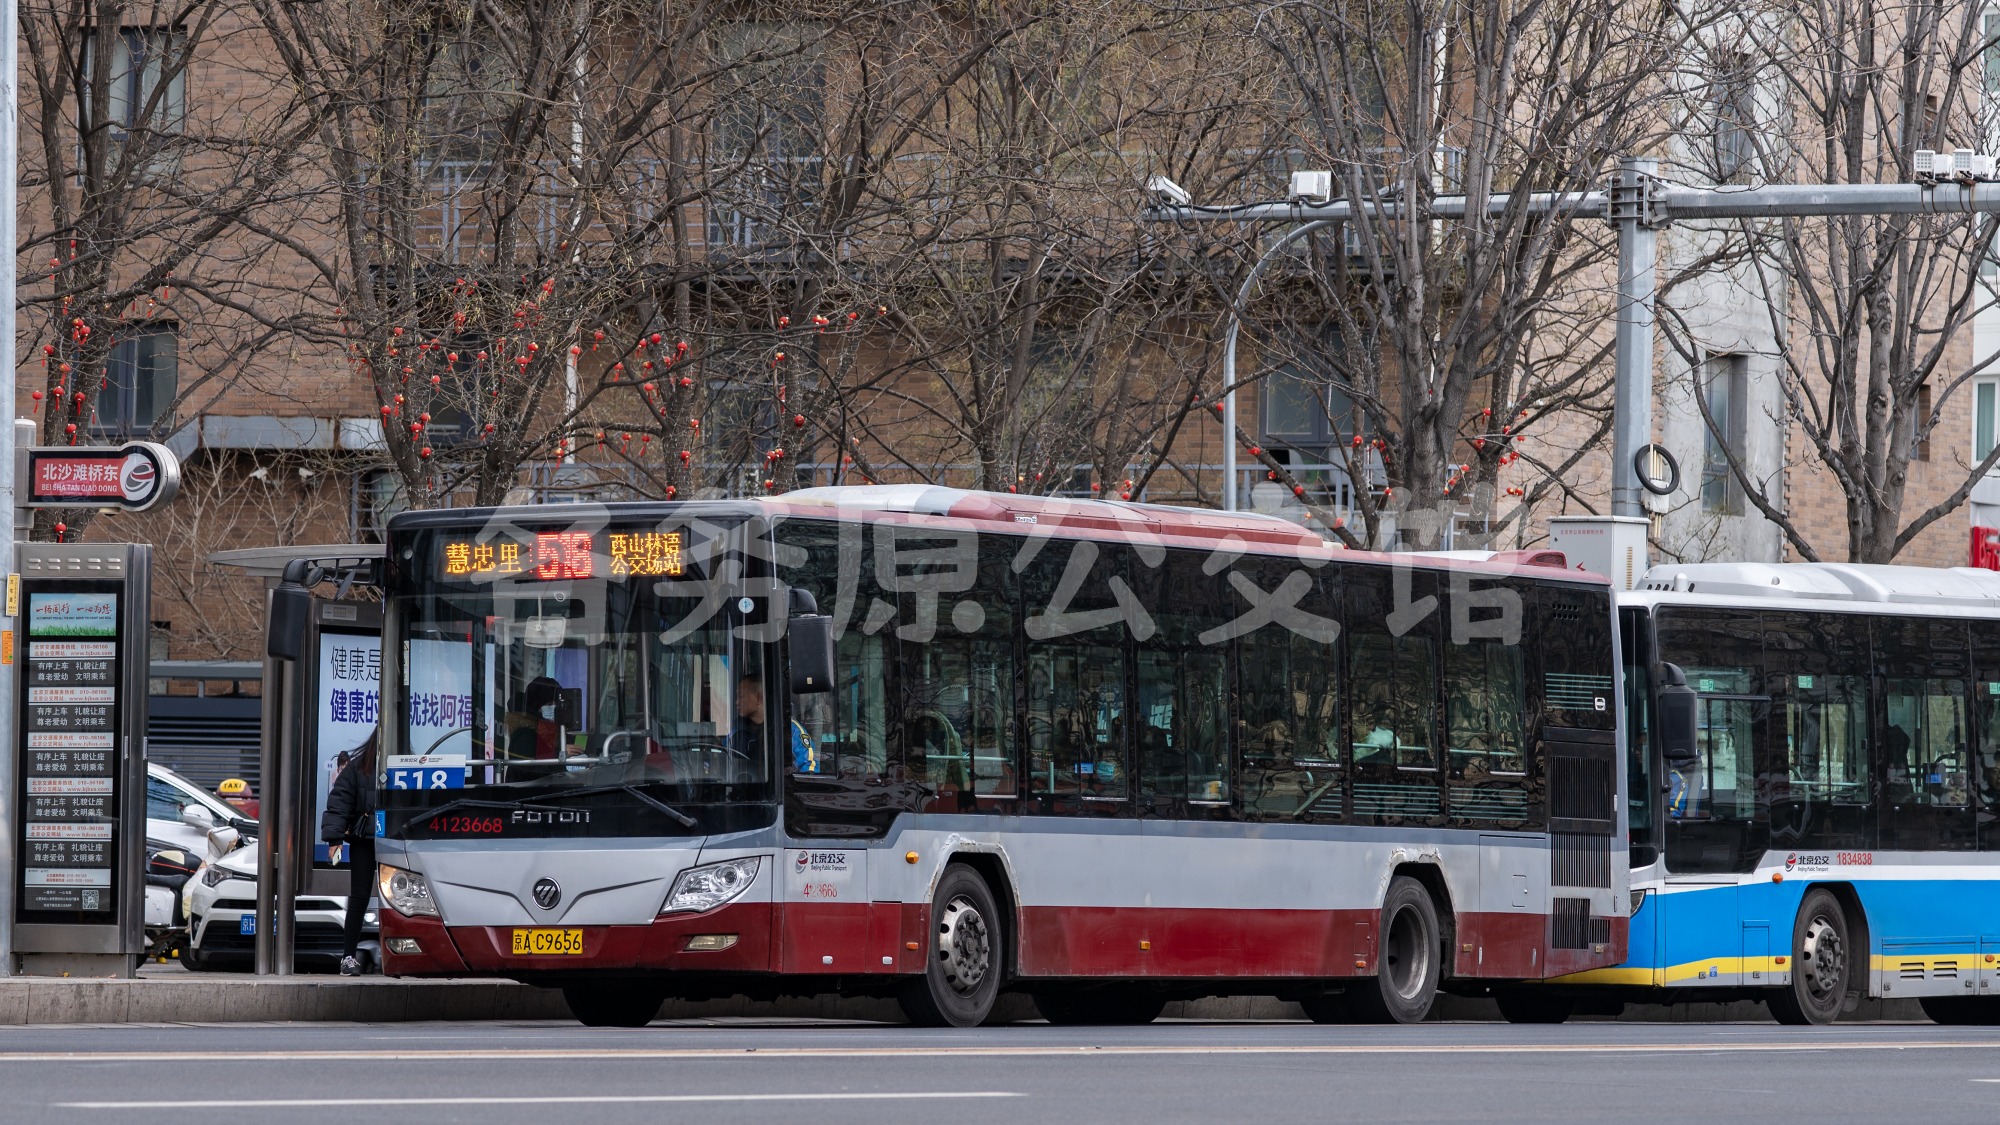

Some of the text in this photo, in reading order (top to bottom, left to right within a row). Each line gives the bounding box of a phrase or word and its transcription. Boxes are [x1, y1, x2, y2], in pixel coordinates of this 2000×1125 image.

[42, 463, 119, 482] 北沙滩桥东
[41, 483, 118, 493] BEI SHA TAN QIAO DONG
[610, 533, 681, 555] 西山林语
[446, 533, 592, 579] 慧忠里 518
[610, 553, 682, 575] 公交场站
[38, 662, 107, 670] 有序上车 礼貌让座
[330, 645, 380, 682] 健康是
[37, 672, 107, 681] 尊老爱幼 文明乘车
[37, 707, 106, 716] 有序上车 礼貌让座
[37, 718, 106, 726] 尊老爱幼 文明乘车
[36, 752, 105, 761] 有序上车 礼貌让座
[35, 763, 105, 772] 尊老爱幼 文明乘车
[394, 769, 448, 790] 518
[35, 798, 104, 806] 有序上车 礼貌让座
[35, 808, 104, 817] 尊老爱幼 文明乘车
[429, 816, 503, 833] 4123668
[34, 843, 103, 852] 有序上车 礼貌让座
[34, 853, 103, 862] 尊老爱幼 文明乘车
[810, 853, 846, 865] 北京公交
[1797, 855, 1830, 865] 北京公交
[1836, 852, 1873, 866] 1834838
